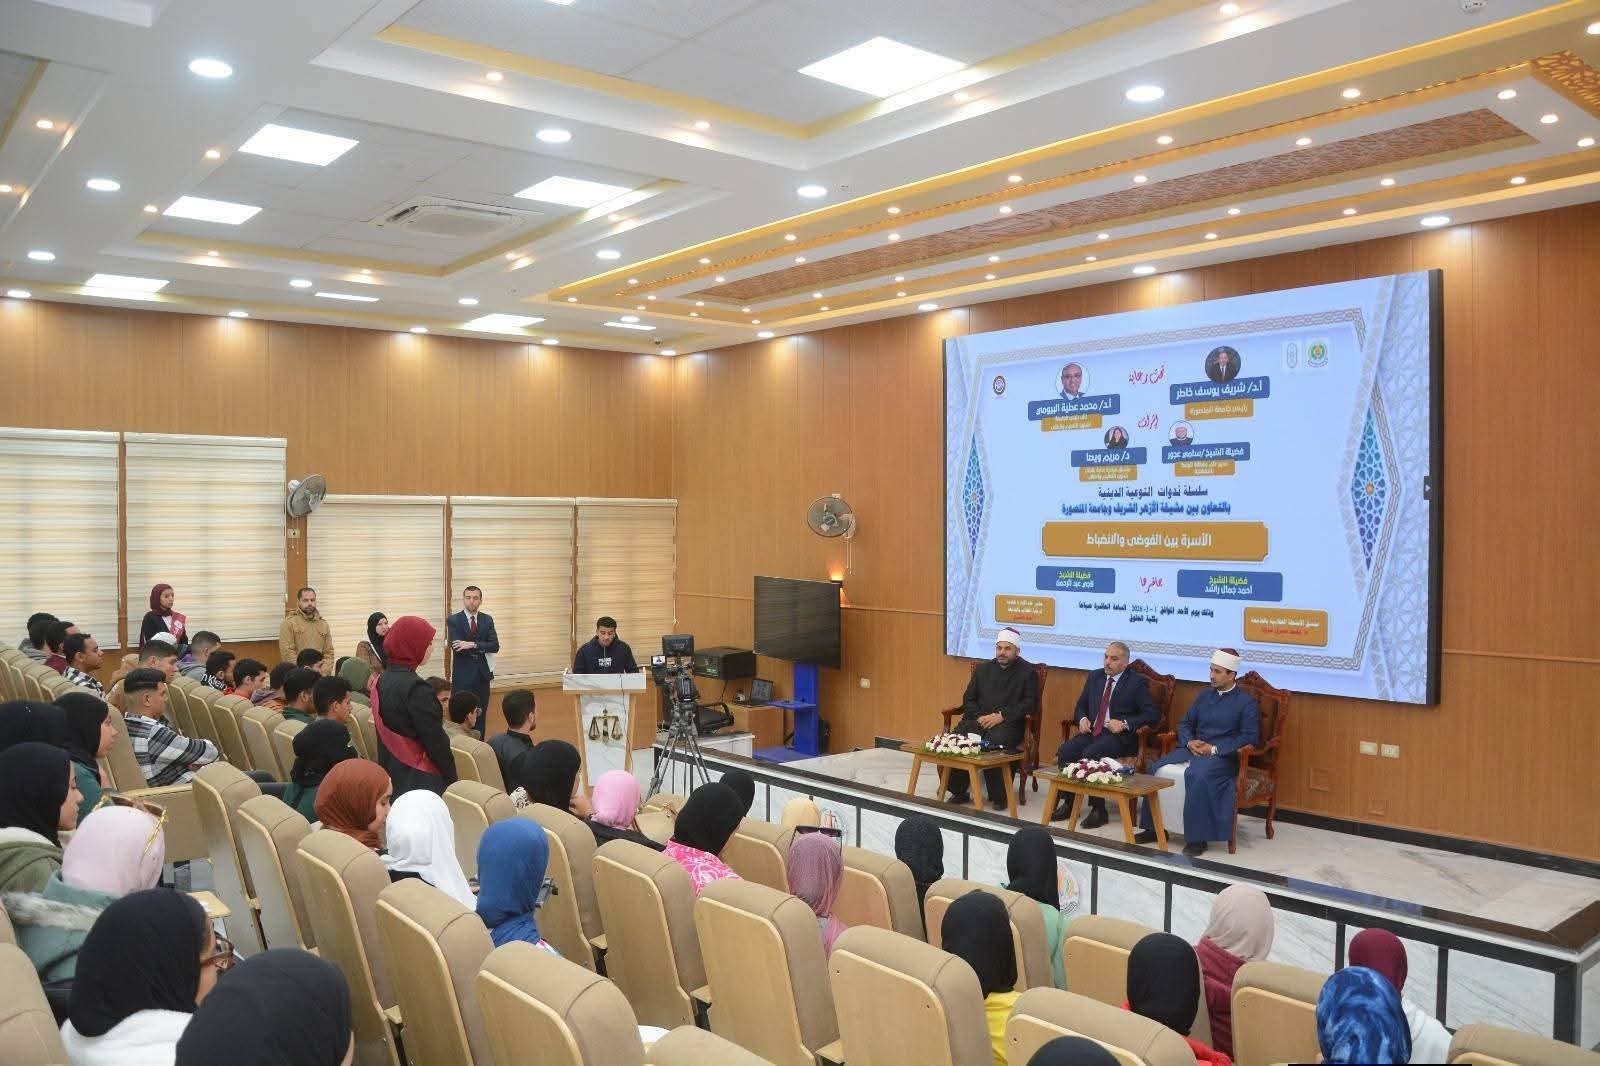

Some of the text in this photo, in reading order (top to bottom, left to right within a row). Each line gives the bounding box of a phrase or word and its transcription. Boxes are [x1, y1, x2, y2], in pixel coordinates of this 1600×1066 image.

[1176, 386, 1194, 400] خاطر
[1195, 386, 1220, 398] يوسف
[1221, 382, 1246, 396] شريف
[1061, 402, 1079, 413] عطية
[1080, 403, 1098, 412] محمد
[1214, 405, 1231, 414] جامعة
[1102, 453, 1120, 462] مريم
[1206, 448, 1224, 458] الشيخ
[1098, 484, 1208, 500] سلسلة ندوات التوعية الدينية
[1062, 503, 1087, 516] المنصورة
[1088, 503, 1112, 517] وجامعة
[1113, 503, 1138, 517] الشريف
[1138, 501, 1159, 517] الأزهر
[1186, 504, 1199, 517] بين
[1201, 501, 1231, 516] بالتعاون
[1086, 532, 1212, 548] الأسرة بين الفوضى والانضباط
[1073, 580, 1081, 589] عبد
[1209, 575, 1249, 586] فضيلة الشيخ
[1204, 584, 1220, 595] راشد
[1220, 585, 1237, 596] جمال
